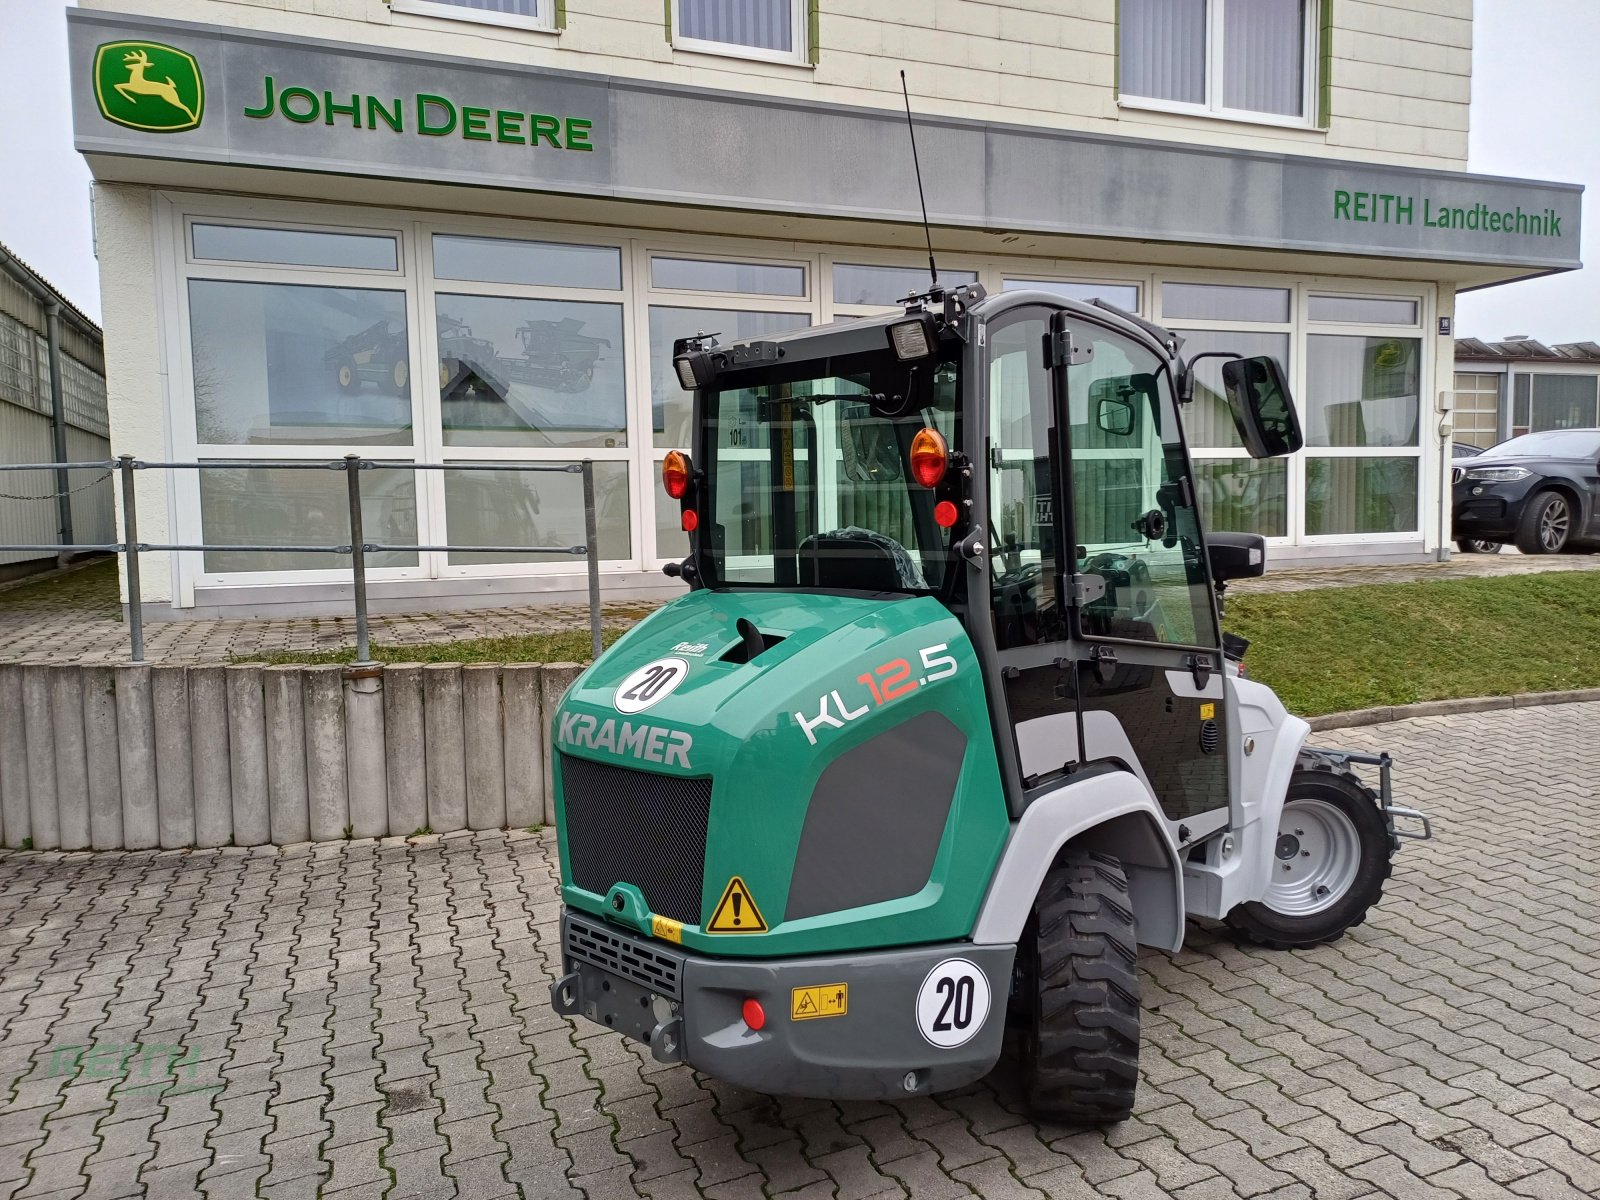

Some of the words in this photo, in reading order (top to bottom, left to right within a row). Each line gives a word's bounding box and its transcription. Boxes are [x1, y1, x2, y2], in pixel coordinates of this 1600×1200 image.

[244, 75, 404, 133] JOHN
[416, 92, 594, 152] DEERE
[1334, 190, 1413, 226] REITH
[1423, 198, 1562, 238] Landtechnik
[730, 428, 741, 446] 101
[621, 665, 678, 701] 20
[557, 710, 693, 769] KRAMER
[932, 974, 976, 1033] 20
